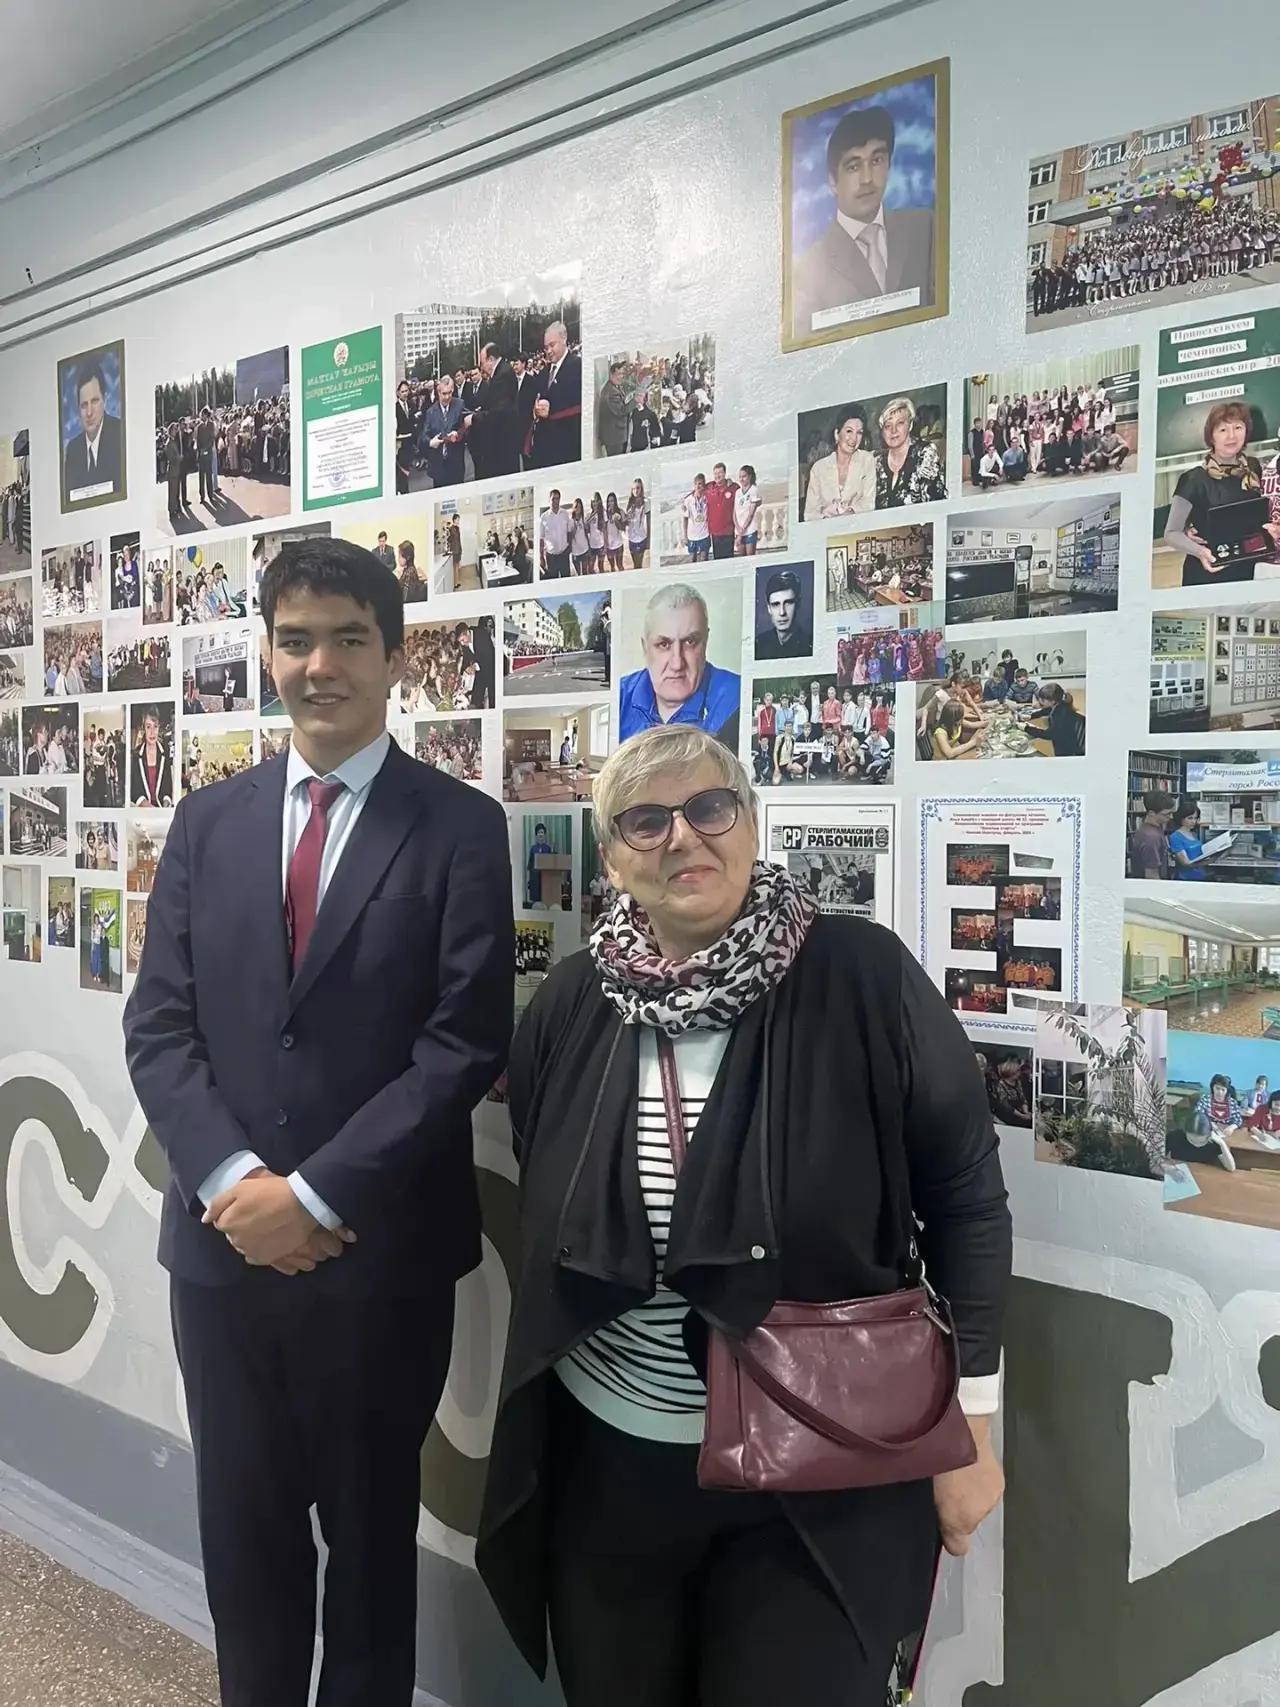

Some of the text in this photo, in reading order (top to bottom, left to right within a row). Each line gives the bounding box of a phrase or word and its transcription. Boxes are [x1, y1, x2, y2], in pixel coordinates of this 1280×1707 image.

[1174, 320, 1251, 341] Приветствуем
[1180, 342, 1243, 360] чемпионку
[1237, 361, 1257, 372] игр
[1196, 387, 1242, 401] Лондоне
[1203, 767, 1267, 778] Стерлитамак
[1228, 780, 1253, 790] город
[783, 826, 874, 848] СР СТЕРЛИТАМАКСКИЙ
[807, 834, 874, 848] РАБОЧИЙ
